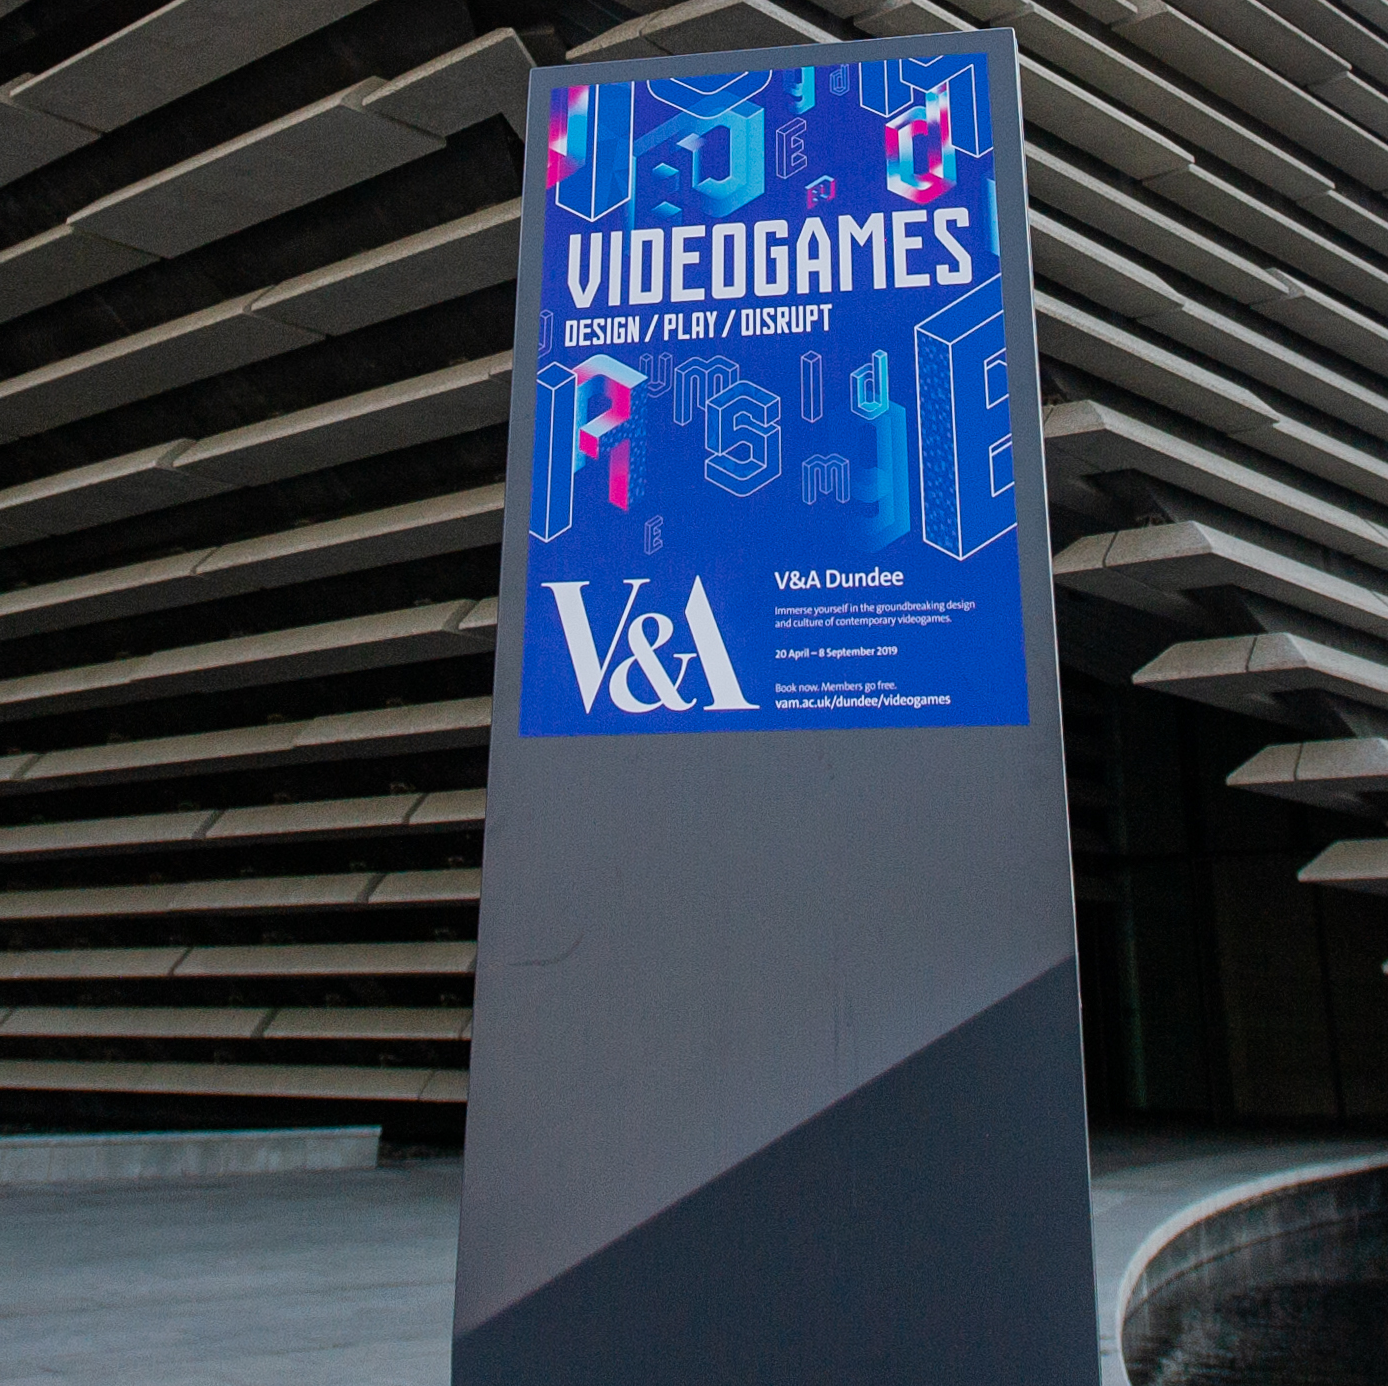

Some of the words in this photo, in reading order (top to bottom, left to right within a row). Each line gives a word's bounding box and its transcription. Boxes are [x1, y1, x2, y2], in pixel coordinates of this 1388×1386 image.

[567, 207, 973, 309] VIDEOGAMES
[564, 315, 641, 347] DESIGN
[663, 311, 717, 341] PLAY
[740, 303, 833, 337] DISRUPT
[774, 570, 821, 590] V&A
[825, 566, 904, 589] Dundee
[774, 606, 813, 616] Immerse
[814, 603, 849, 616] yourself
[849, 603, 859, 613] in
[860, 602, 875, 613] the
[875, 600, 946, 614] groundbreaking
[946, 599, 976, 612] design
[774, 618, 792, 628] and
[792, 617, 824, 628] culture
[824, 616, 835, 626] of
[835, 616, 897, 628] contemporary
[897, 613, 952, 626] videogames.
[541, 574, 760, 715] V&A
[775, 649, 787, 659] 20
[788, 648, 810, 660] April
[818, 648, 825, 658] 8
[826, 646, 875, 659] September
[876, 645, 898, 656] 2019
[775, 683, 797, 693] Book
[798, 684, 820, 693] now.
[821, 681, 863, 692] Members
[864, 683, 876, 693] go
[877, 680, 897, 691] free.
[775, 694, 951, 710] vam.ac.uk/dundee/videogames
